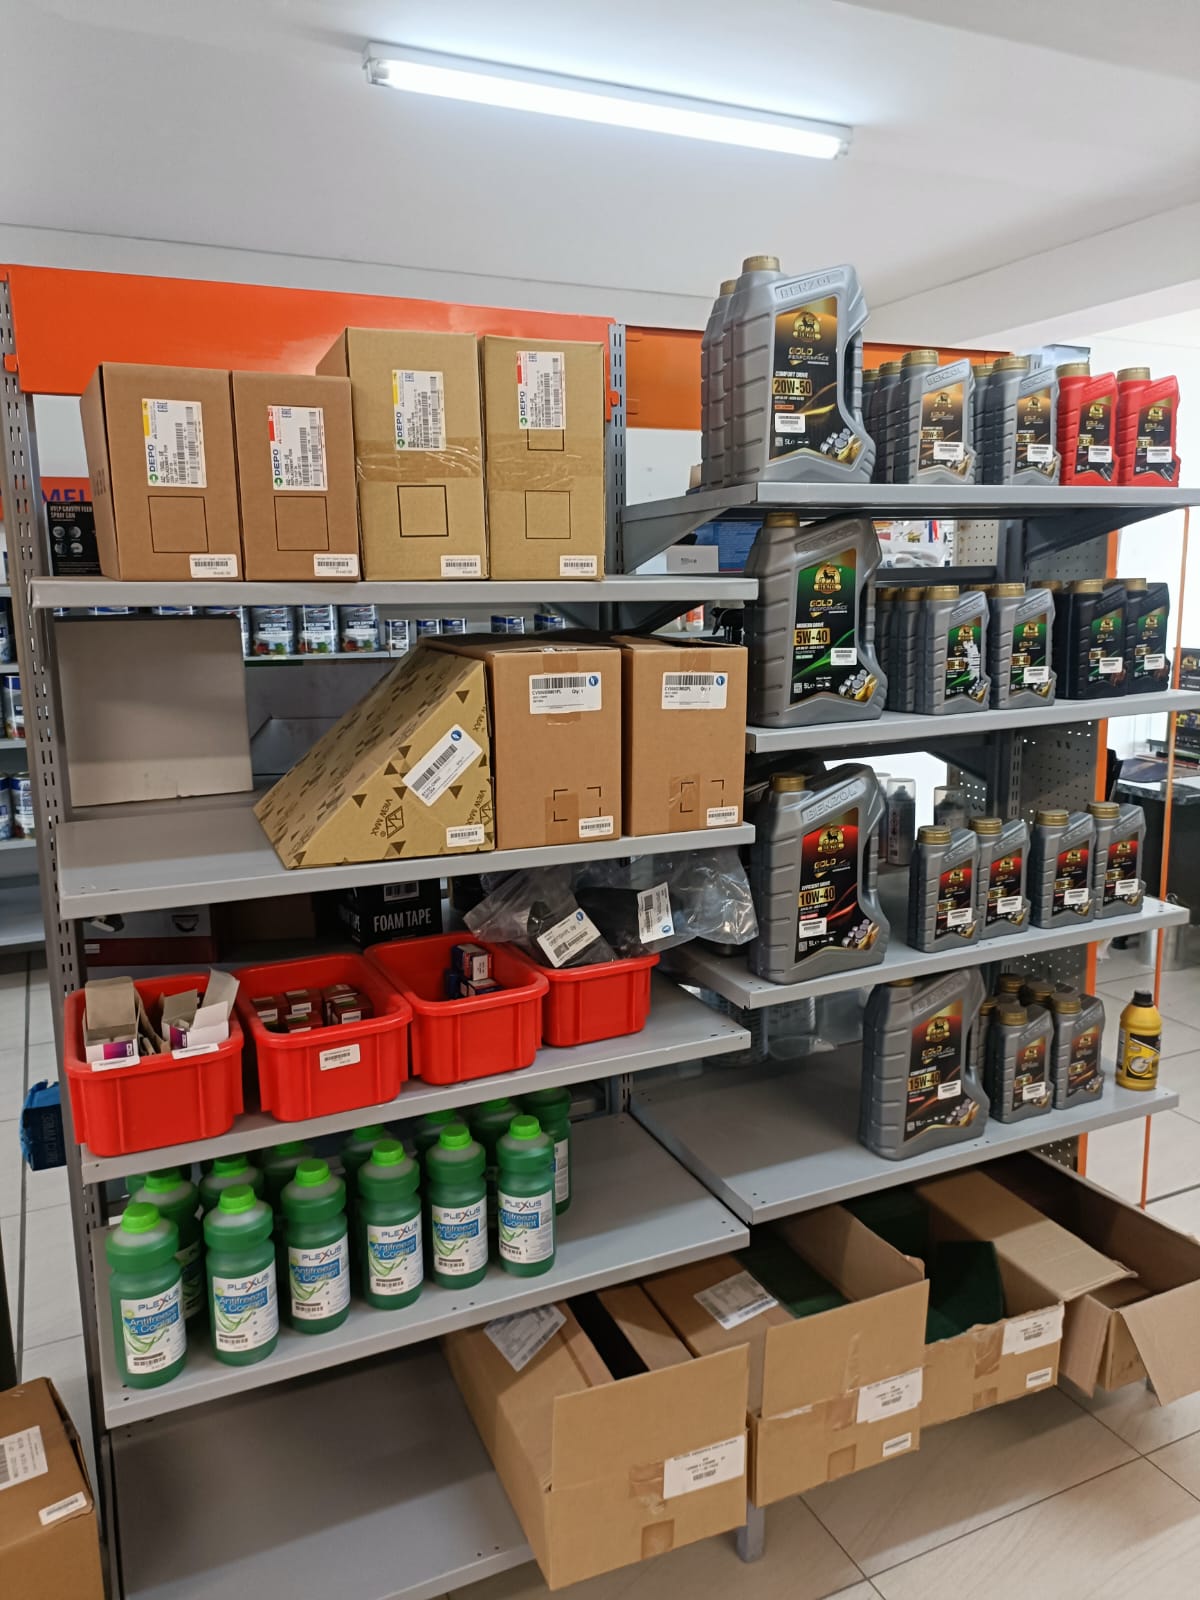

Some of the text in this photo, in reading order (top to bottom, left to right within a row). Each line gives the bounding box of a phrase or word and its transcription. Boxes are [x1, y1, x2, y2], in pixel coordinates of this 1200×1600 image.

[789, 347, 813, 355] GOLD
[774, 379, 811, 394] 20W-50
[147, 444, 156, 472] DEPO
[272, 449, 281, 476] DEPO
[810, 599, 833, 608] GOLD
[796, 630, 828, 644] 5W-40
[474, 790, 487, 808] VIEW
[807, 788, 858, 822] BENZOL
[370, 799, 393, 836] VIEW MAX
[814, 858, 837, 869] GOLD
[800, 887, 835, 906] 10W-40
[373, 912, 404, 933] FOAM
[405, 907, 432, 928] TAPE
[909, 1071, 940, 1090] 15W-40
[505, 1199, 542, 1212] PLEXUS
[443, 1206, 481, 1222] PLEXUS
[382, 1221, 418, 1239] PLEXUS
[437, 1220, 478, 1233] Antifreeze
[506, 1219, 537, 1228] Coolant
[445, 1229, 478, 1240] Coolant
[374, 1238, 416, 1251] Antifreeze
[382, 1245, 416, 1258] Coolant
[302, 1245, 342, 1263] PLEXUS
[294, 1263, 338, 1274] Antifreeze
[304, 1270, 338, 1282] Coolant
[227, 1273, 270, 1293] PLEXUS
[138, 1288, 179, 1311] PLEXUS
[219, 1290, 266, 1305] Antifreeze
[228, 1298, 266, 1313] Coolant
[130, 1305, 177, 1327] Antifreeze
[141, 1312, 177, 1333] Coolant
